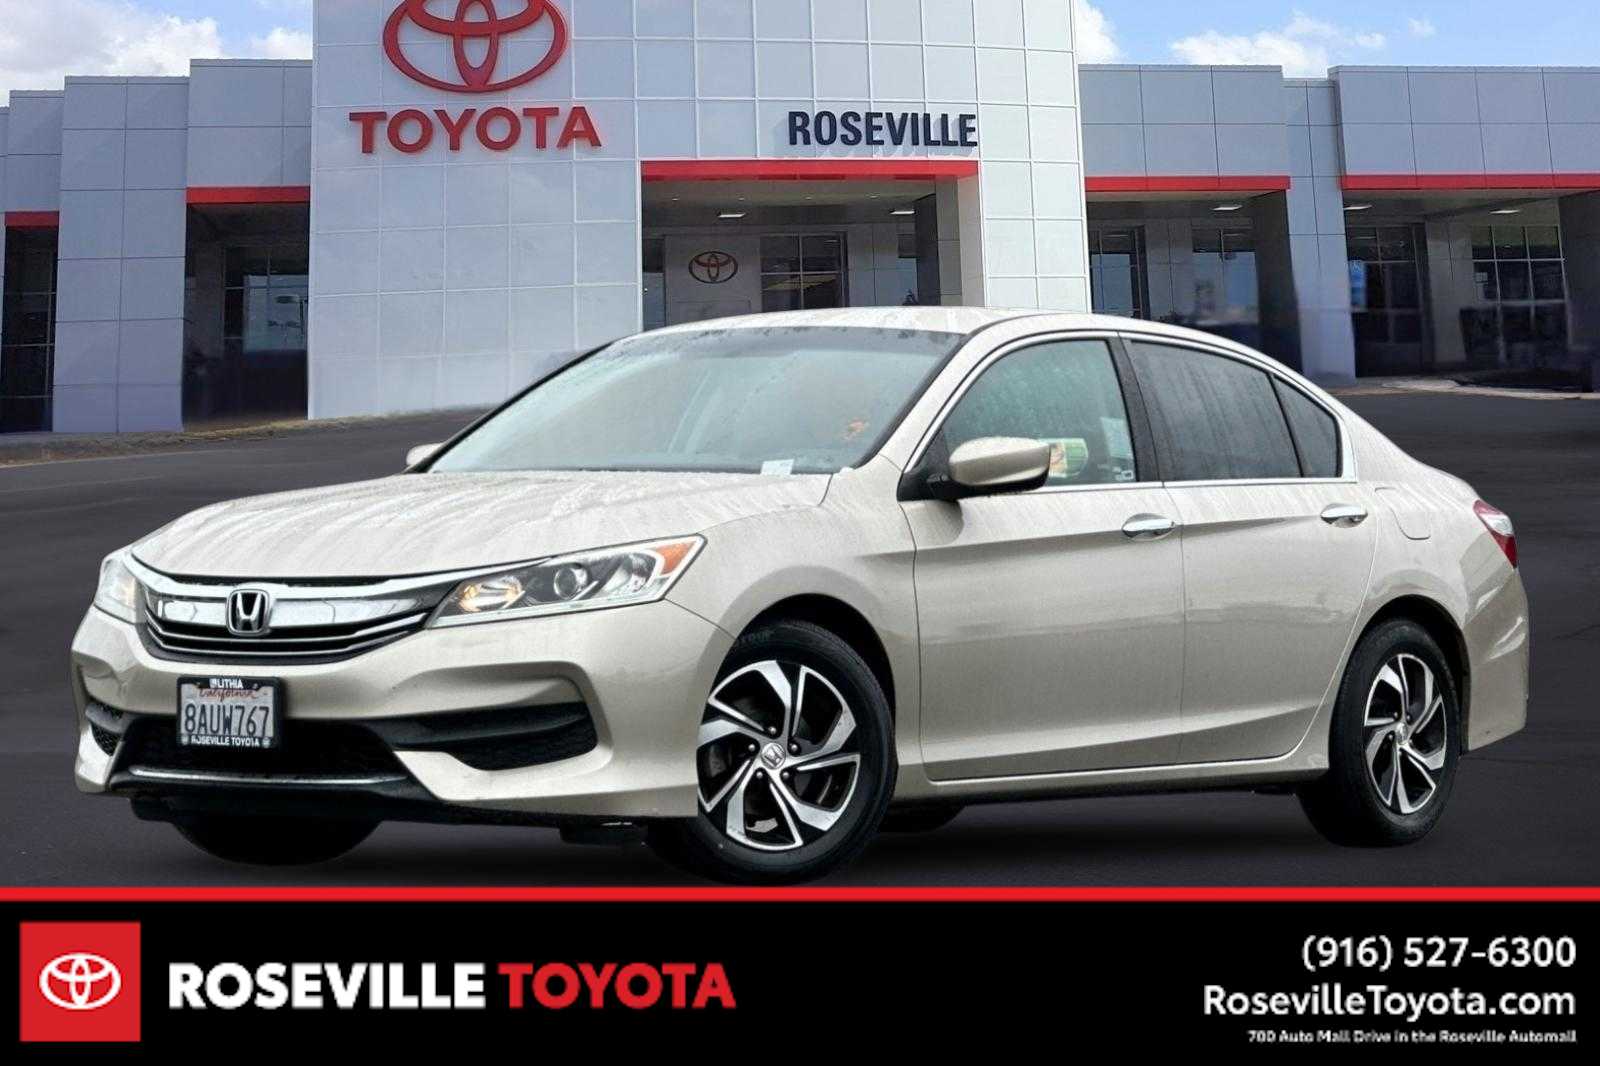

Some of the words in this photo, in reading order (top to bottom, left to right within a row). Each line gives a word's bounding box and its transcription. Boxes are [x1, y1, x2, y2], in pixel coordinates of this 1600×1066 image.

[349, 106, 602, 153] TOYOTA
[788, 110, 978, 147] ROSEVILLE
[199, 688, 258, 701] California
[218, 678, 243, 688] LITHIA
[184, 703, 270, 737] 8AUW767
[191, 735, 230, 746] ROSEVILLE
[232, 736, 260, 747] TOYOTA
